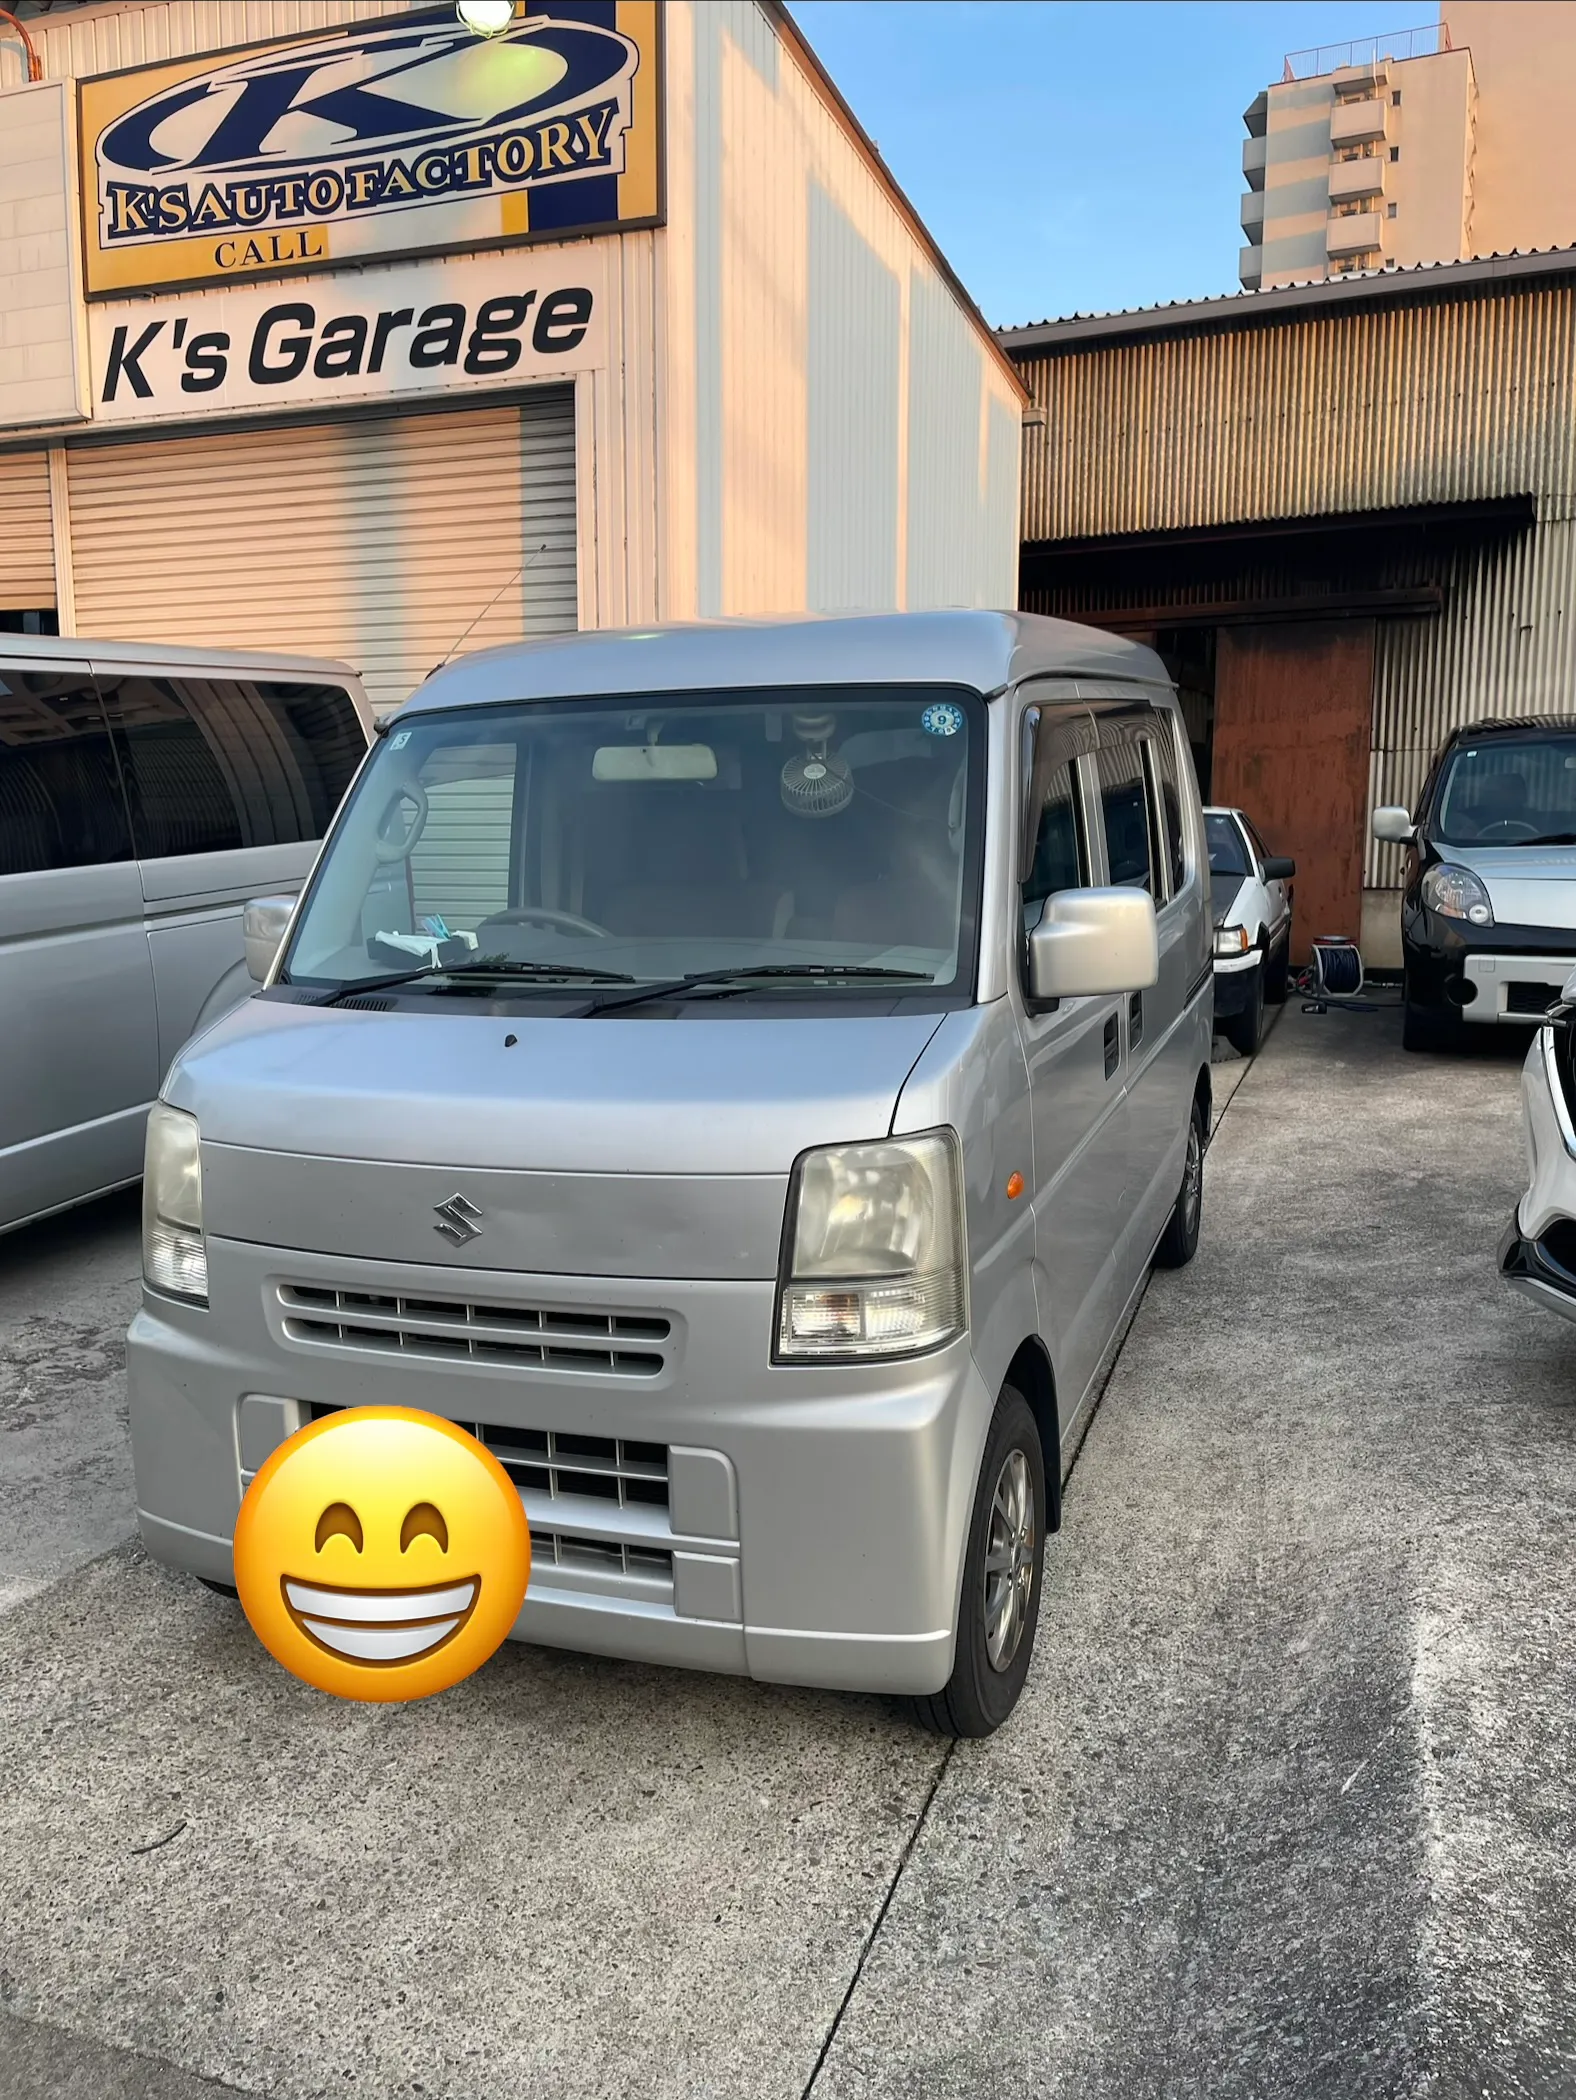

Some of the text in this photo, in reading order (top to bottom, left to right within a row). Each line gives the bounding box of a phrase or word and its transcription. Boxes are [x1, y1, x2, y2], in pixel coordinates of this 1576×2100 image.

[350, 106, 612, 204] FACTORY
[214, 230, 322, 269] CALL
[101, 287, 594, 403] K's Garage
